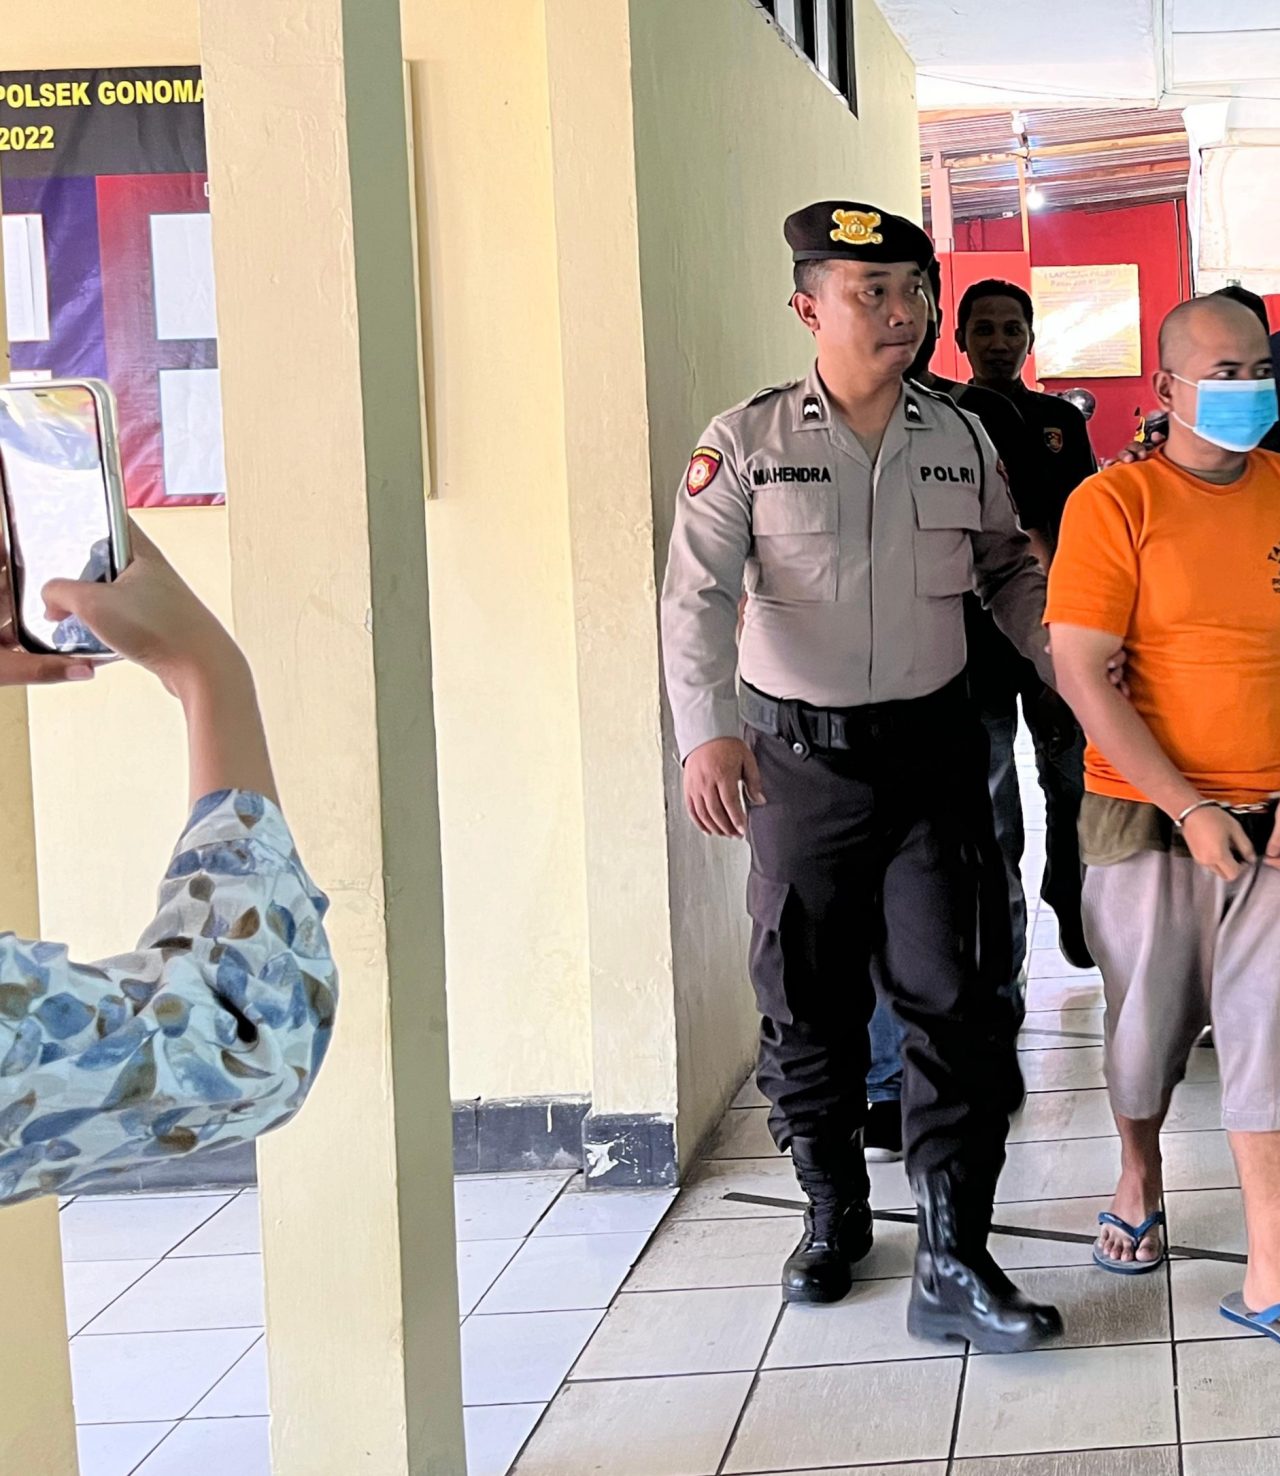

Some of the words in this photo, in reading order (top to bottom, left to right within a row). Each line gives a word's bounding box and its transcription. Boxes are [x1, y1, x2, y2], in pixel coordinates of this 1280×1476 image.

[0, 125, 55, 151] 2022
[753, 466, 832, 486] MAHENDRA
[920, 465, 976, 485] POLRI
